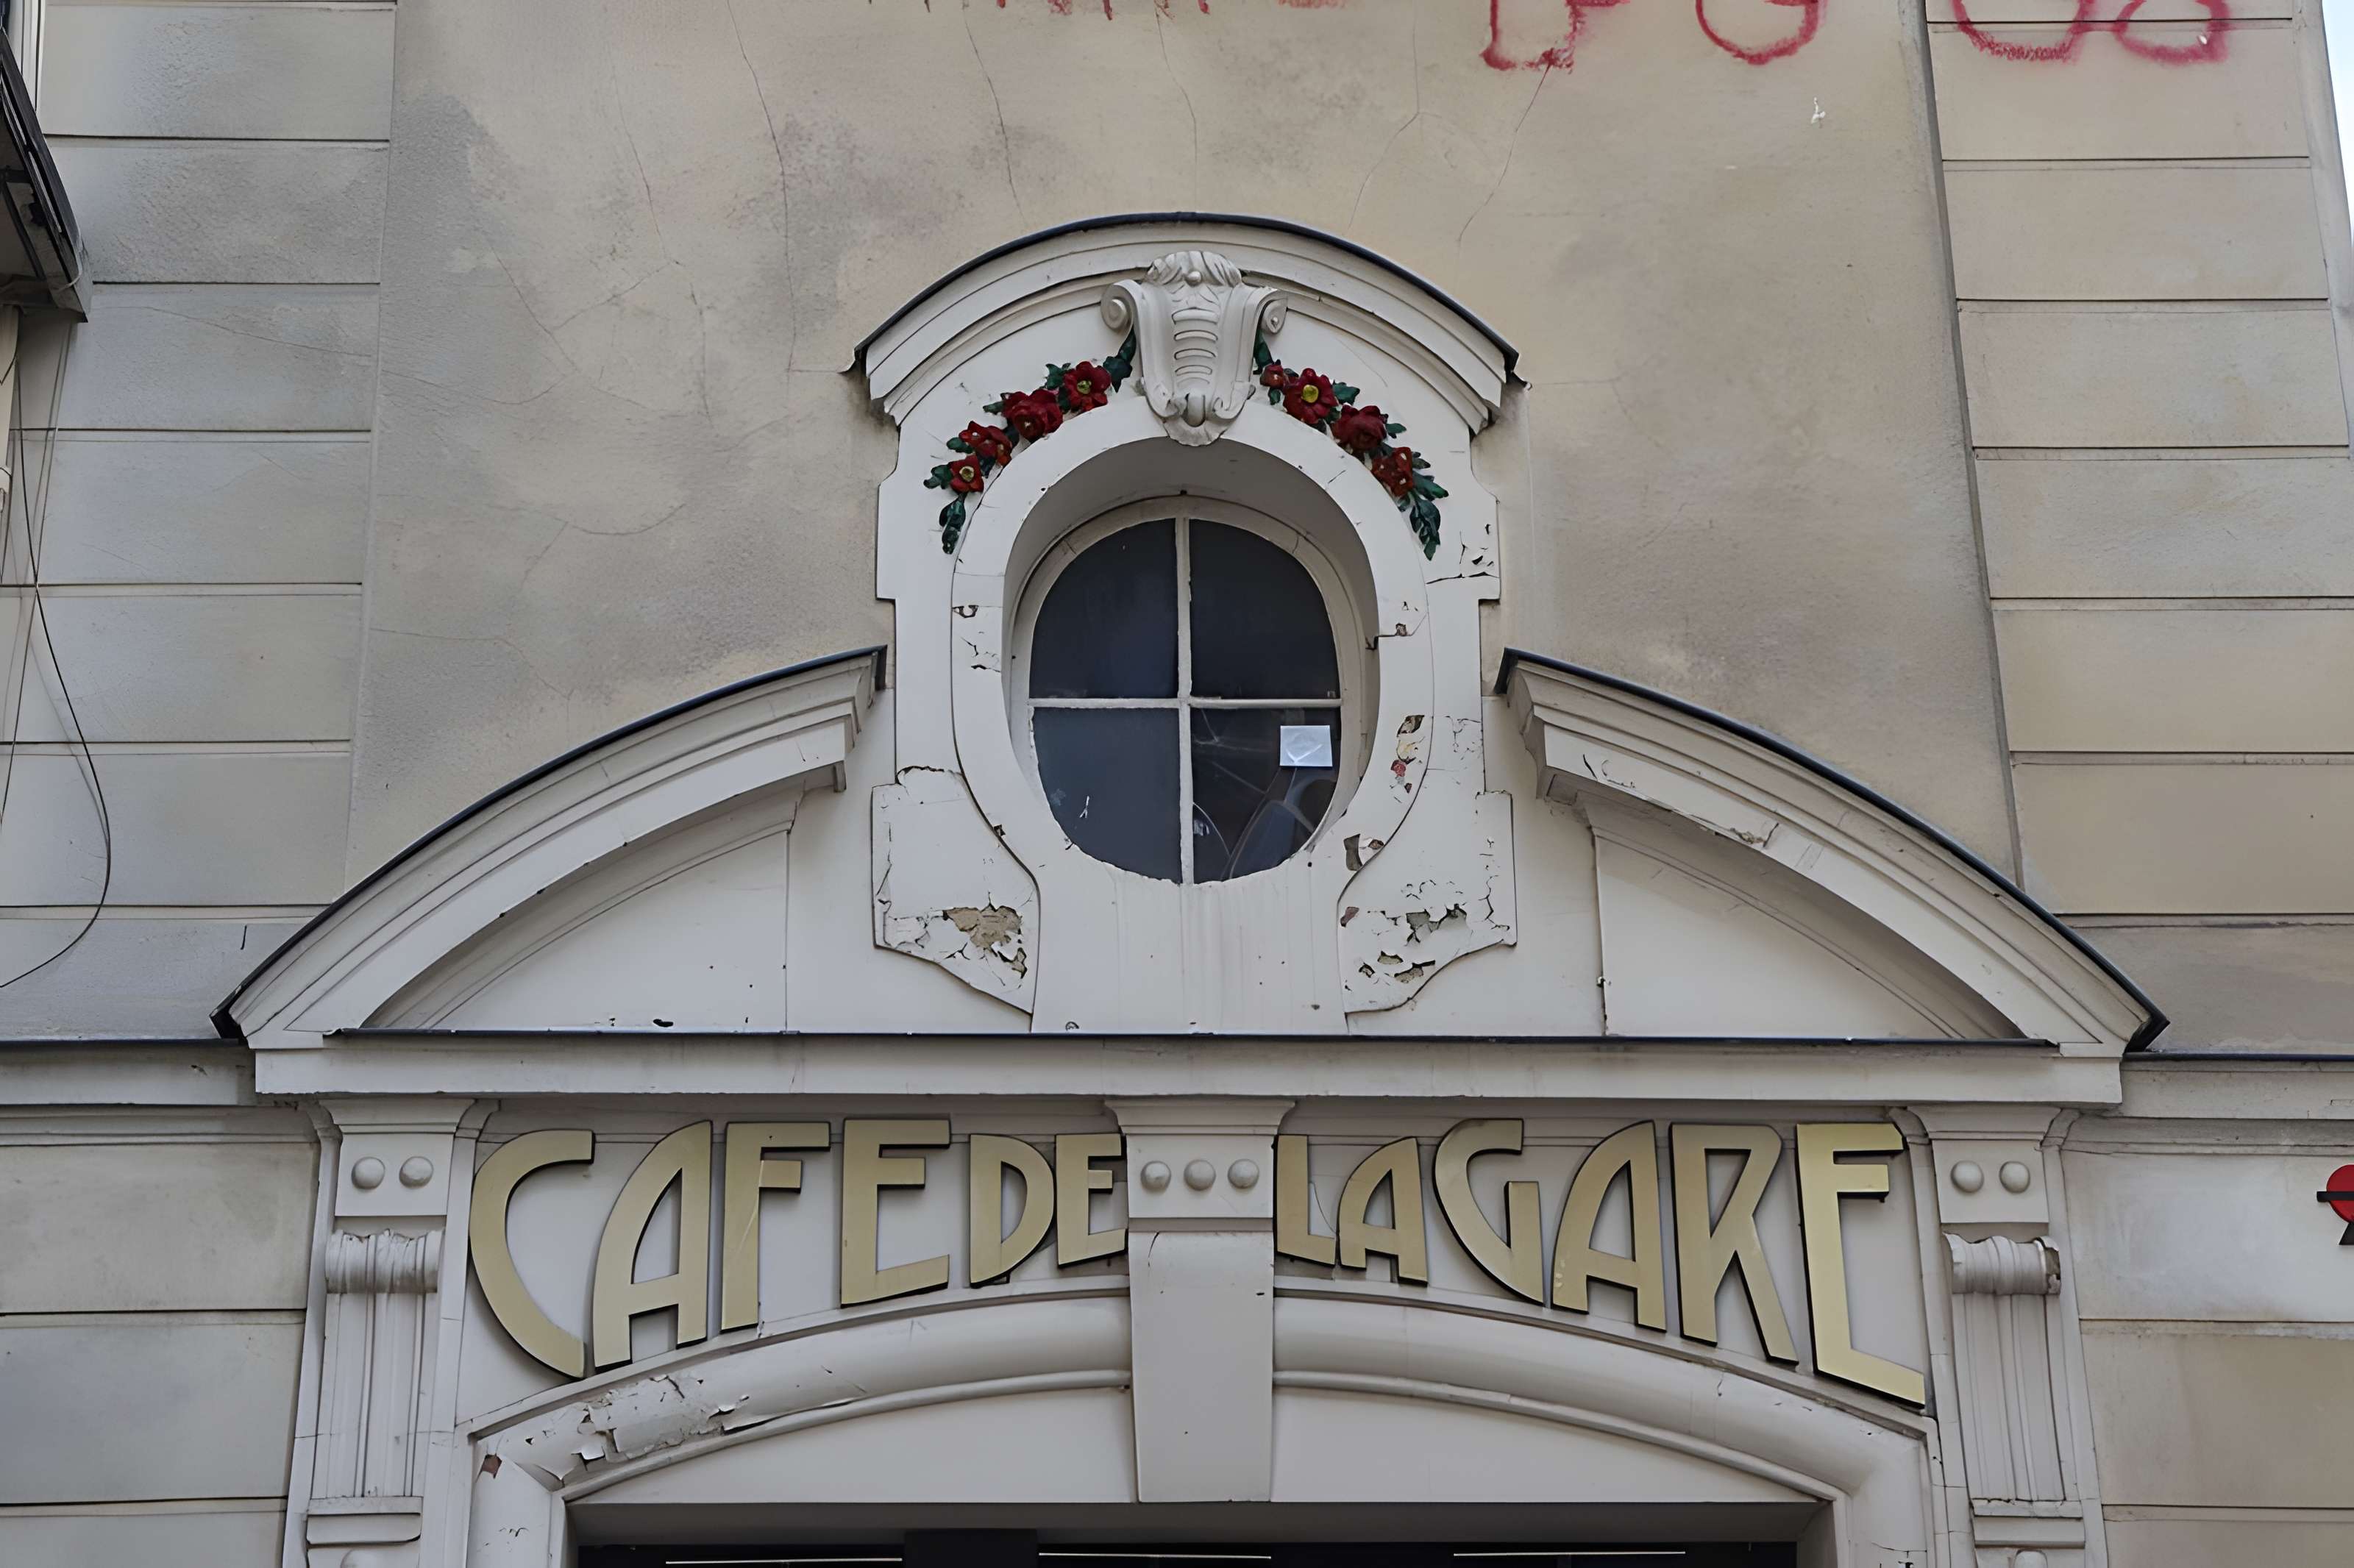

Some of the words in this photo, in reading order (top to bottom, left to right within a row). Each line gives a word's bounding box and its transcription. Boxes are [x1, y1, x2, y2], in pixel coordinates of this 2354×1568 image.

[470, 1119, 950, 1380] CAFE
[969, 1133, 1127, 1288] DE
[1273, 1134, 1428, 1286] LA
[1432, 1119, 1926, 1408] GARE
